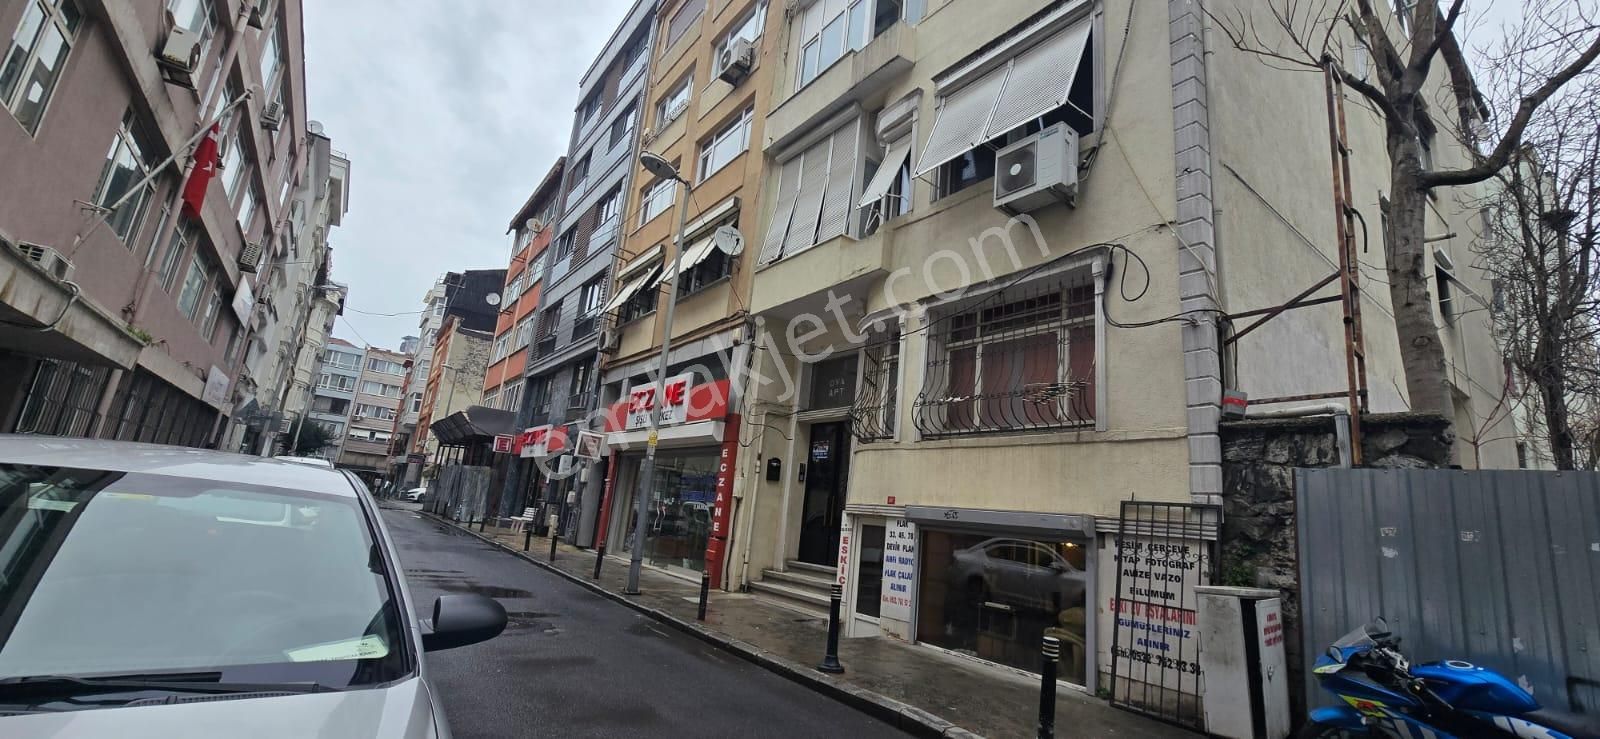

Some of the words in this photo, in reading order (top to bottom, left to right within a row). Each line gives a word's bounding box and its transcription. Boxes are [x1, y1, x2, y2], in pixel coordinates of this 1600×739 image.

[713, 448, 729, 533] ECZANE
[838, 536, 849, 585] ESKİC
[1154, 572, 1182, 584] VAZO
